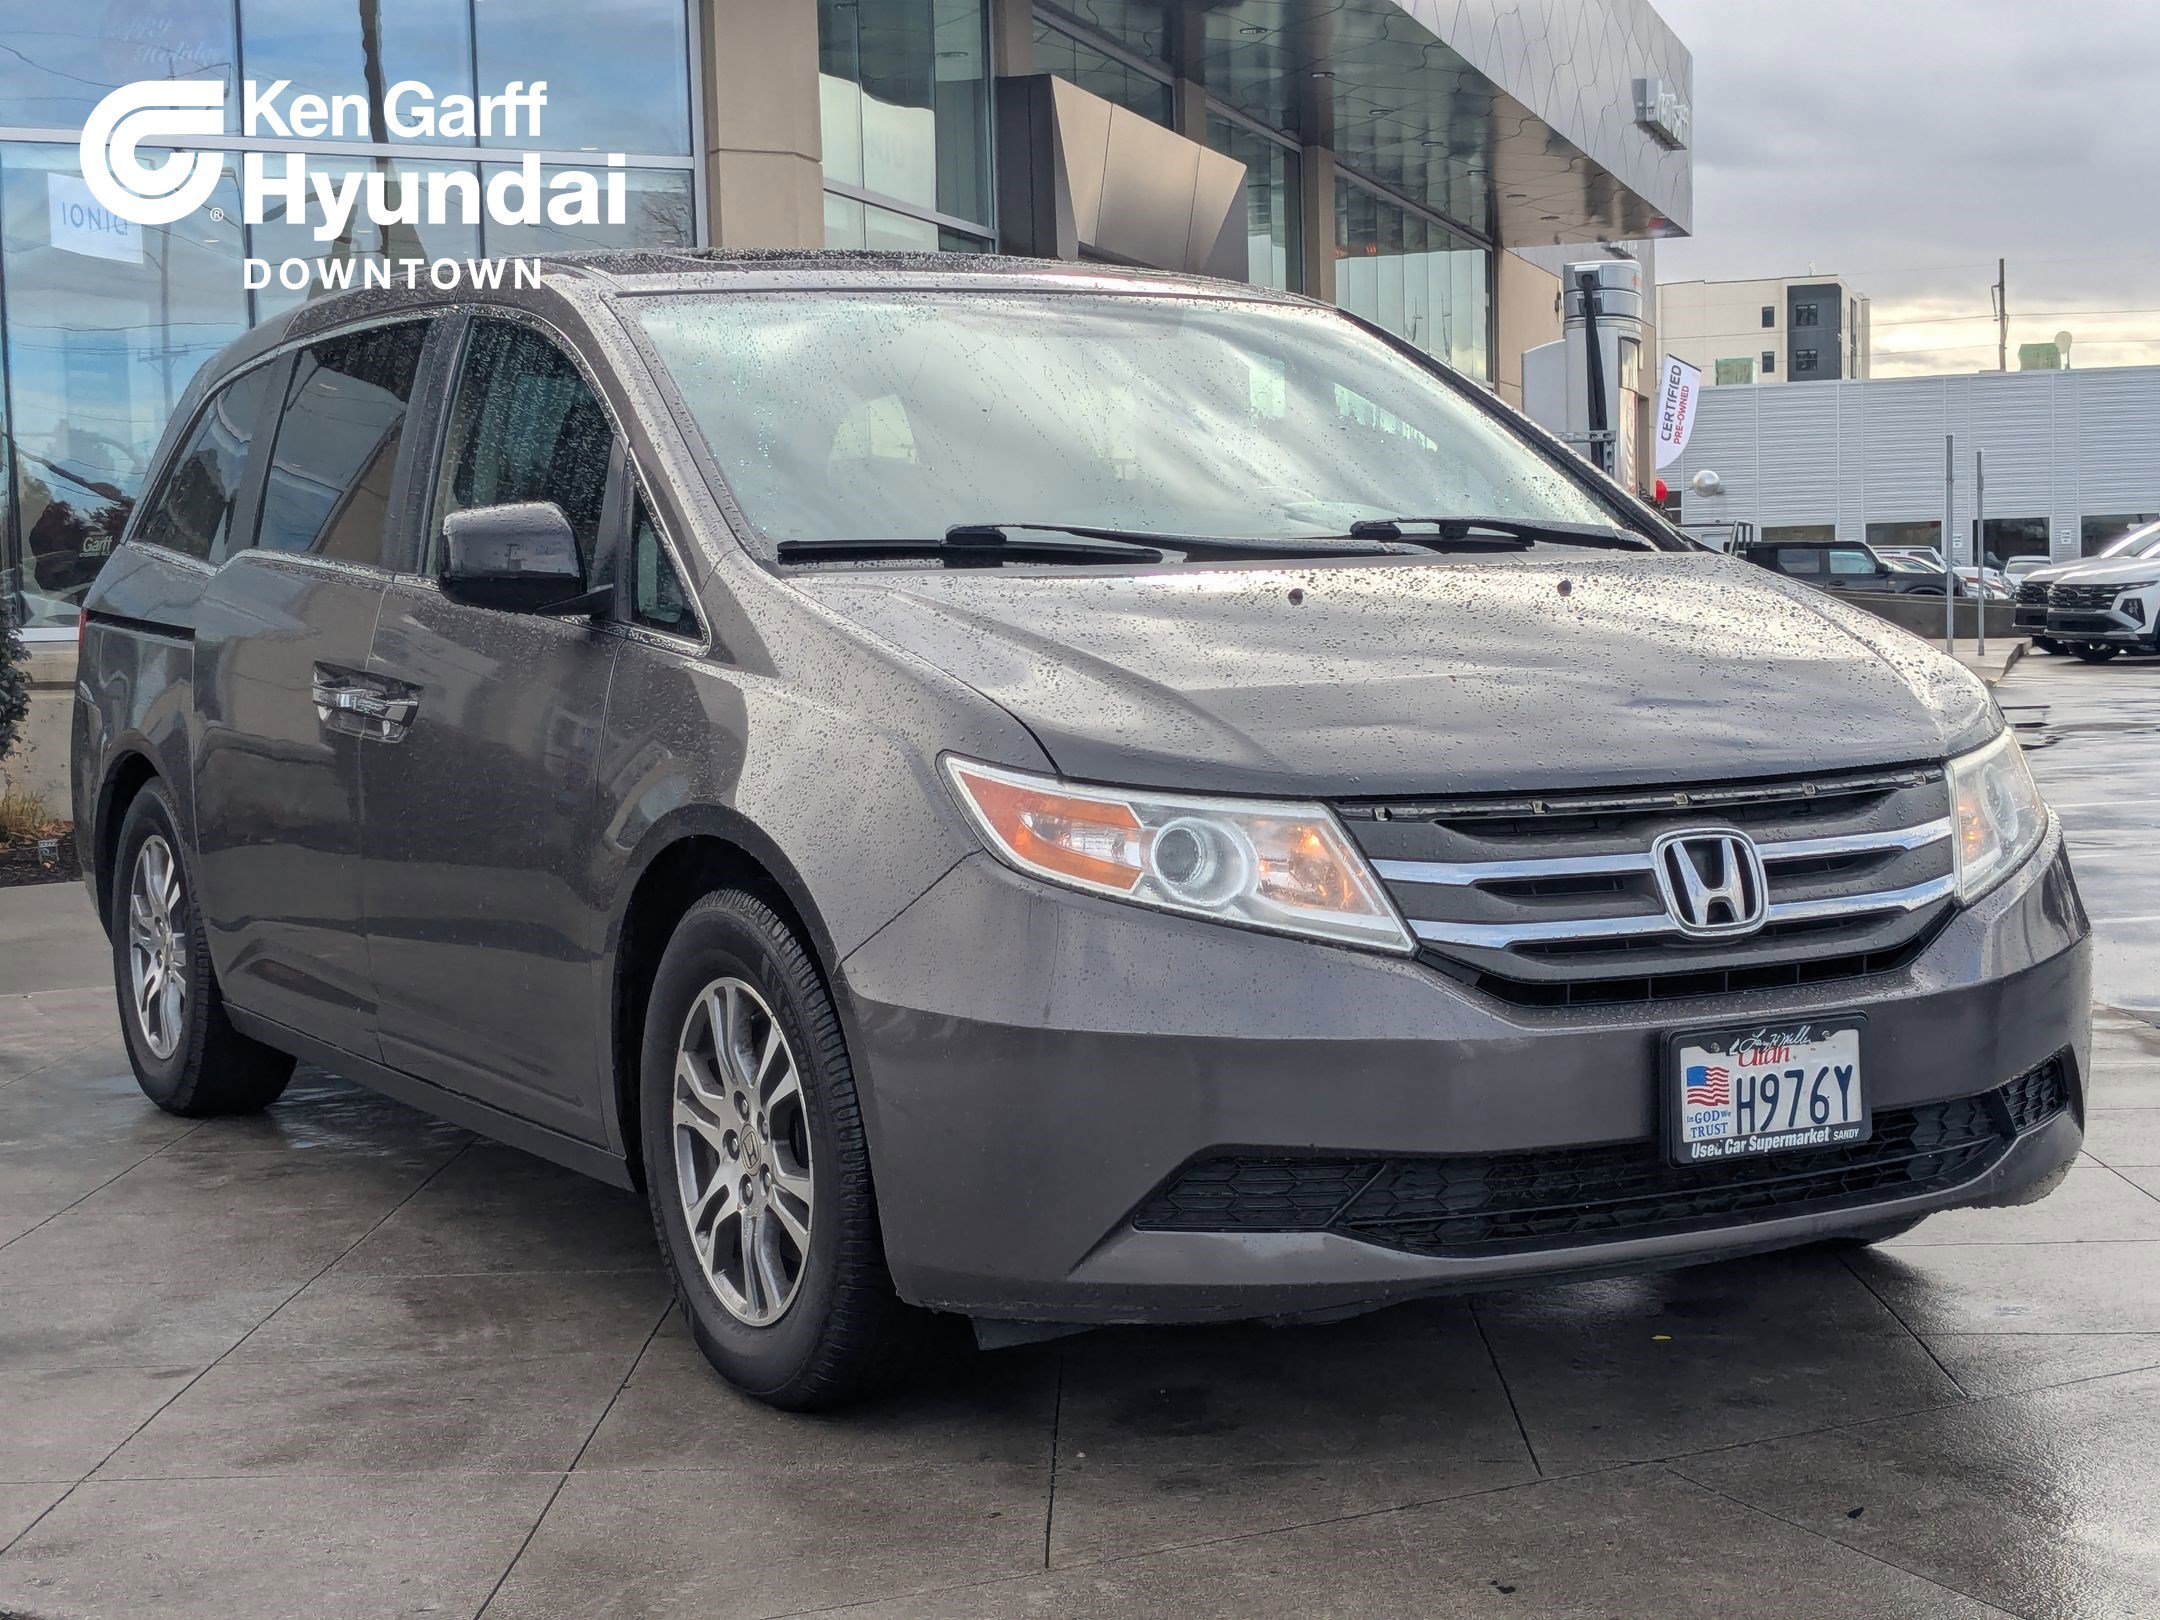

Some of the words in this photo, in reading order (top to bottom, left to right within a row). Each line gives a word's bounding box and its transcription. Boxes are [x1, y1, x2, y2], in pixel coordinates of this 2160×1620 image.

[1660, 364, 1682, 442] CERTIFIED
[1673, 385, 1690, 445] PRE-OWNED
[1694, 1110, 1721, 1124] GOD
[1736, 1064, 1853, 1135] H976Y
[1690, 1122, 1729, 1139] TRUST
[1724, 1138, 1748, 1156] Car
[1748, 1126, 1831, 1153] Supermarket
